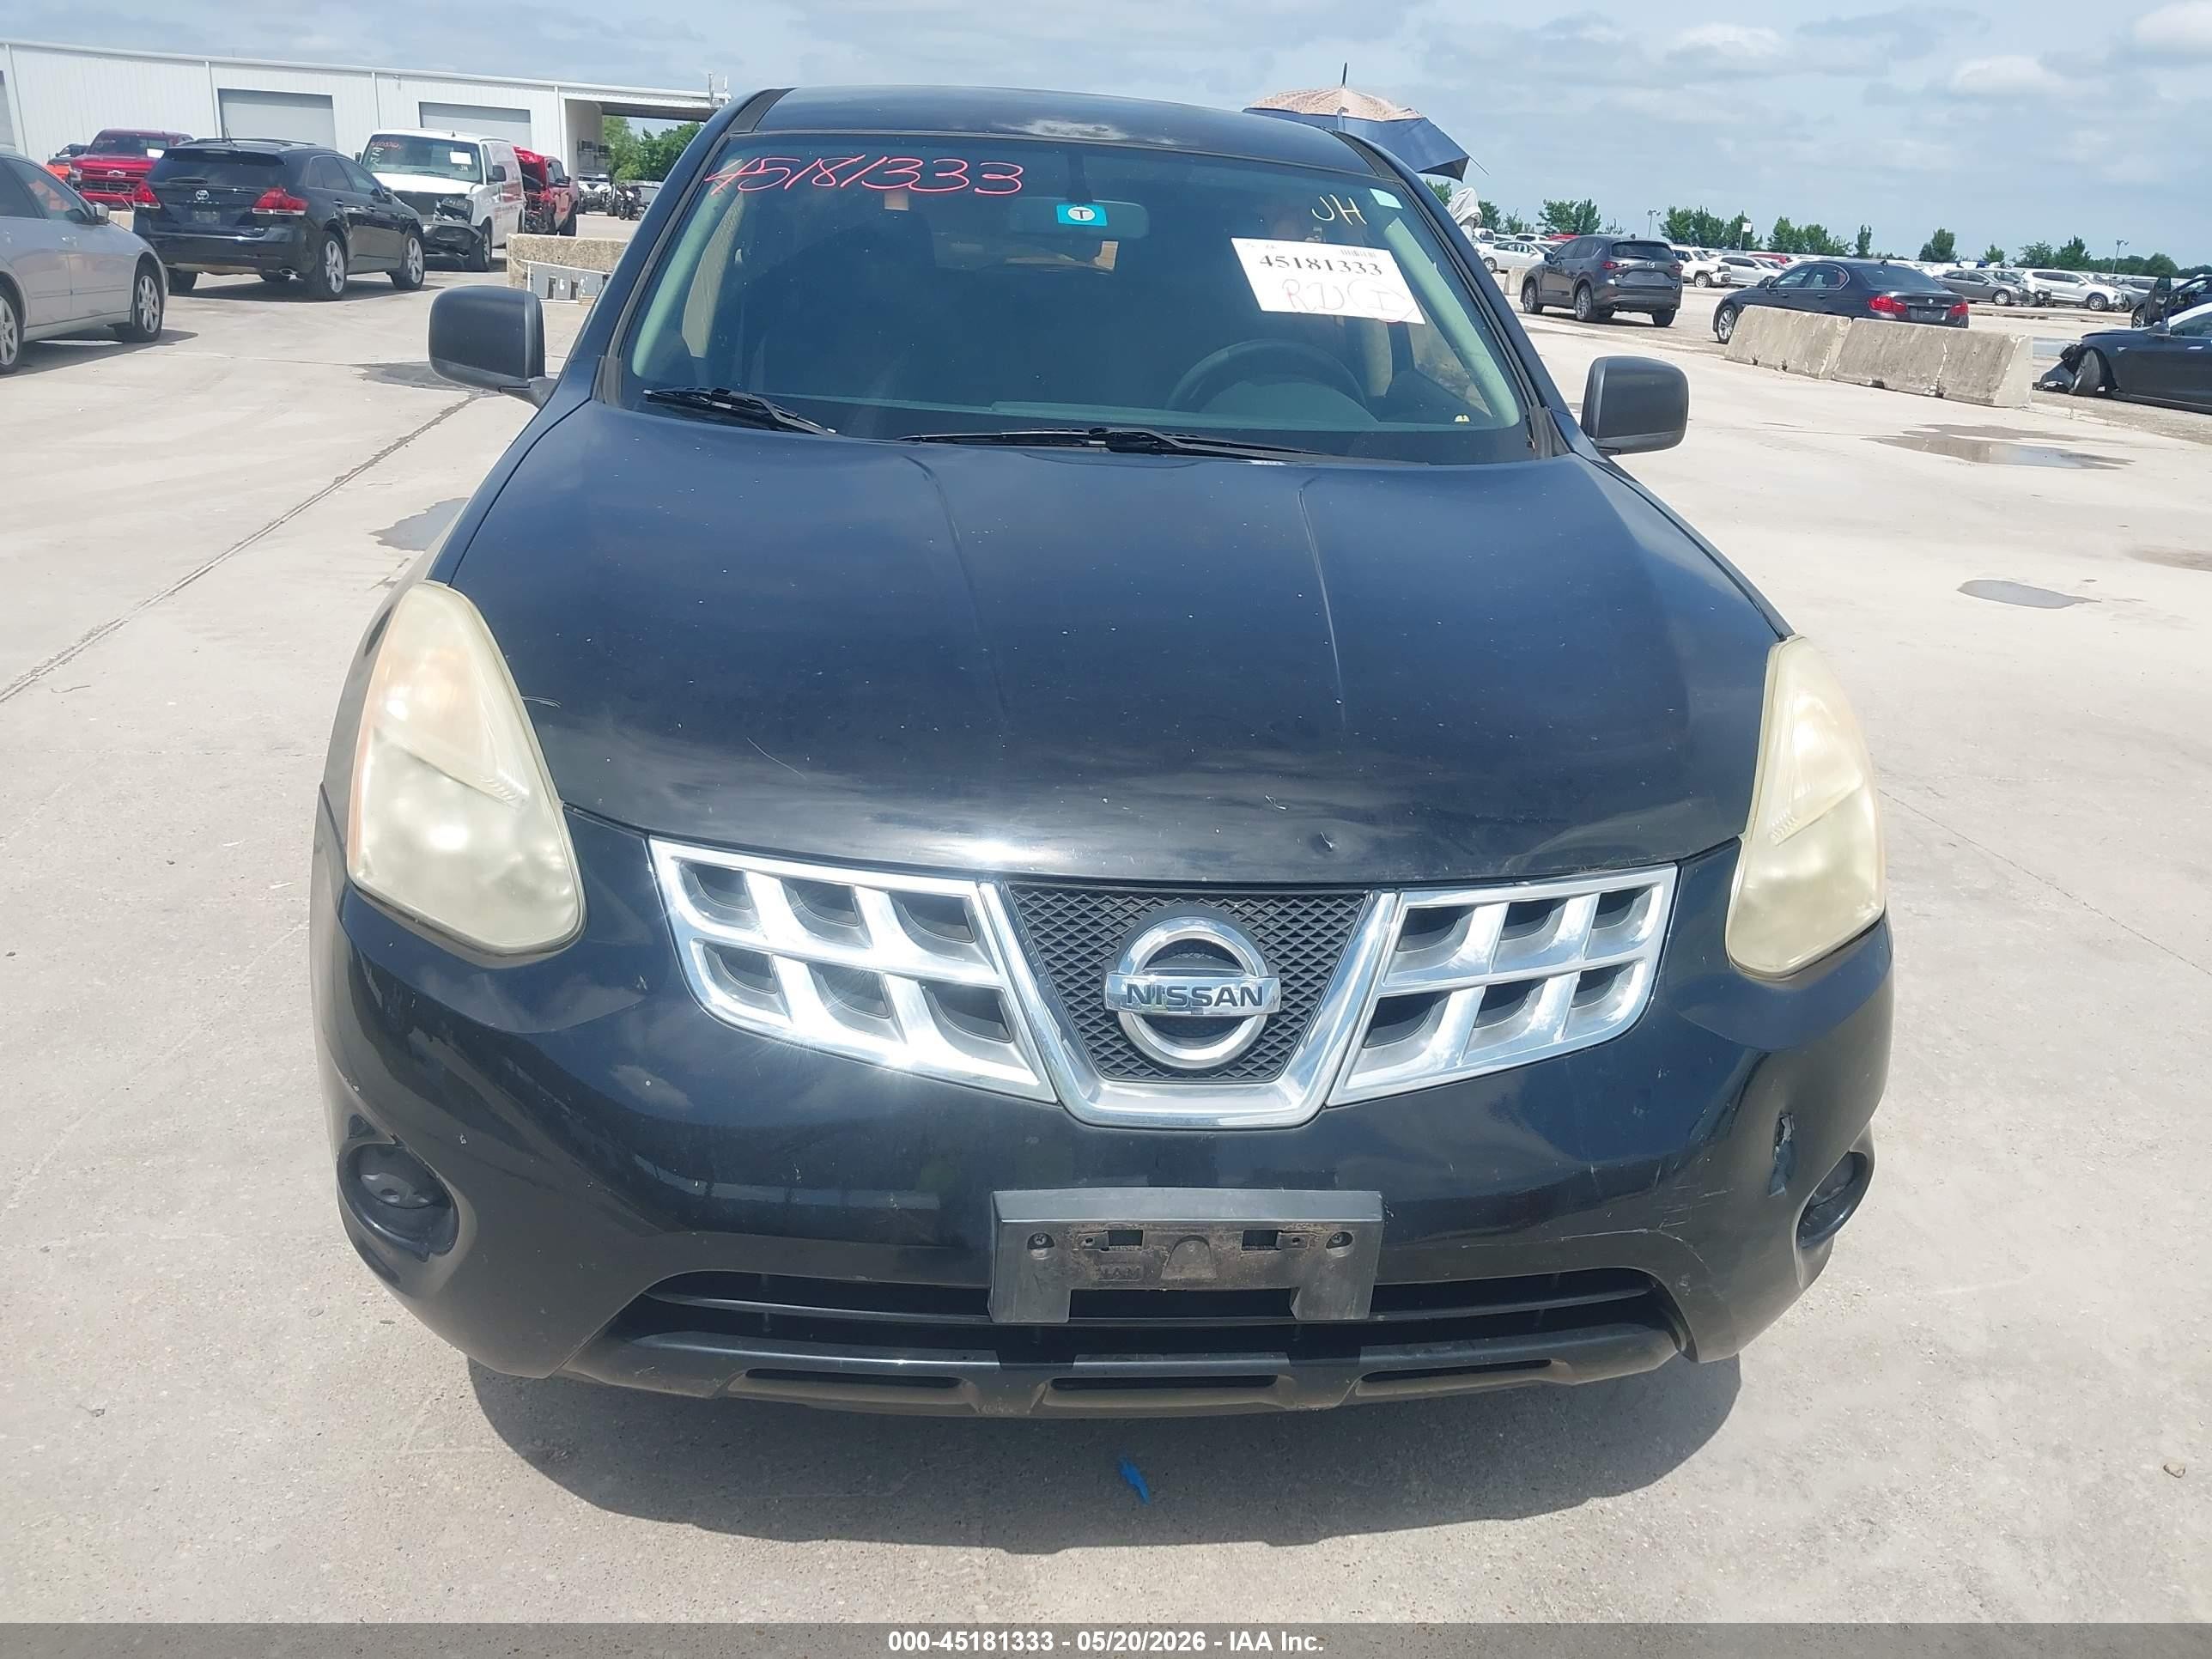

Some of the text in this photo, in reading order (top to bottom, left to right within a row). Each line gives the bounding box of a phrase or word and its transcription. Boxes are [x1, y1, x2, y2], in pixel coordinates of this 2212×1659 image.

[704, 154, 1024, 195] 45181333
[1072, 209, 1091, 220] T
[1311, 194, 1368, 226] JH
[1259, 254, 1382, 276] 45181333
[1126, 982, 1264, 1008] NISSAN
